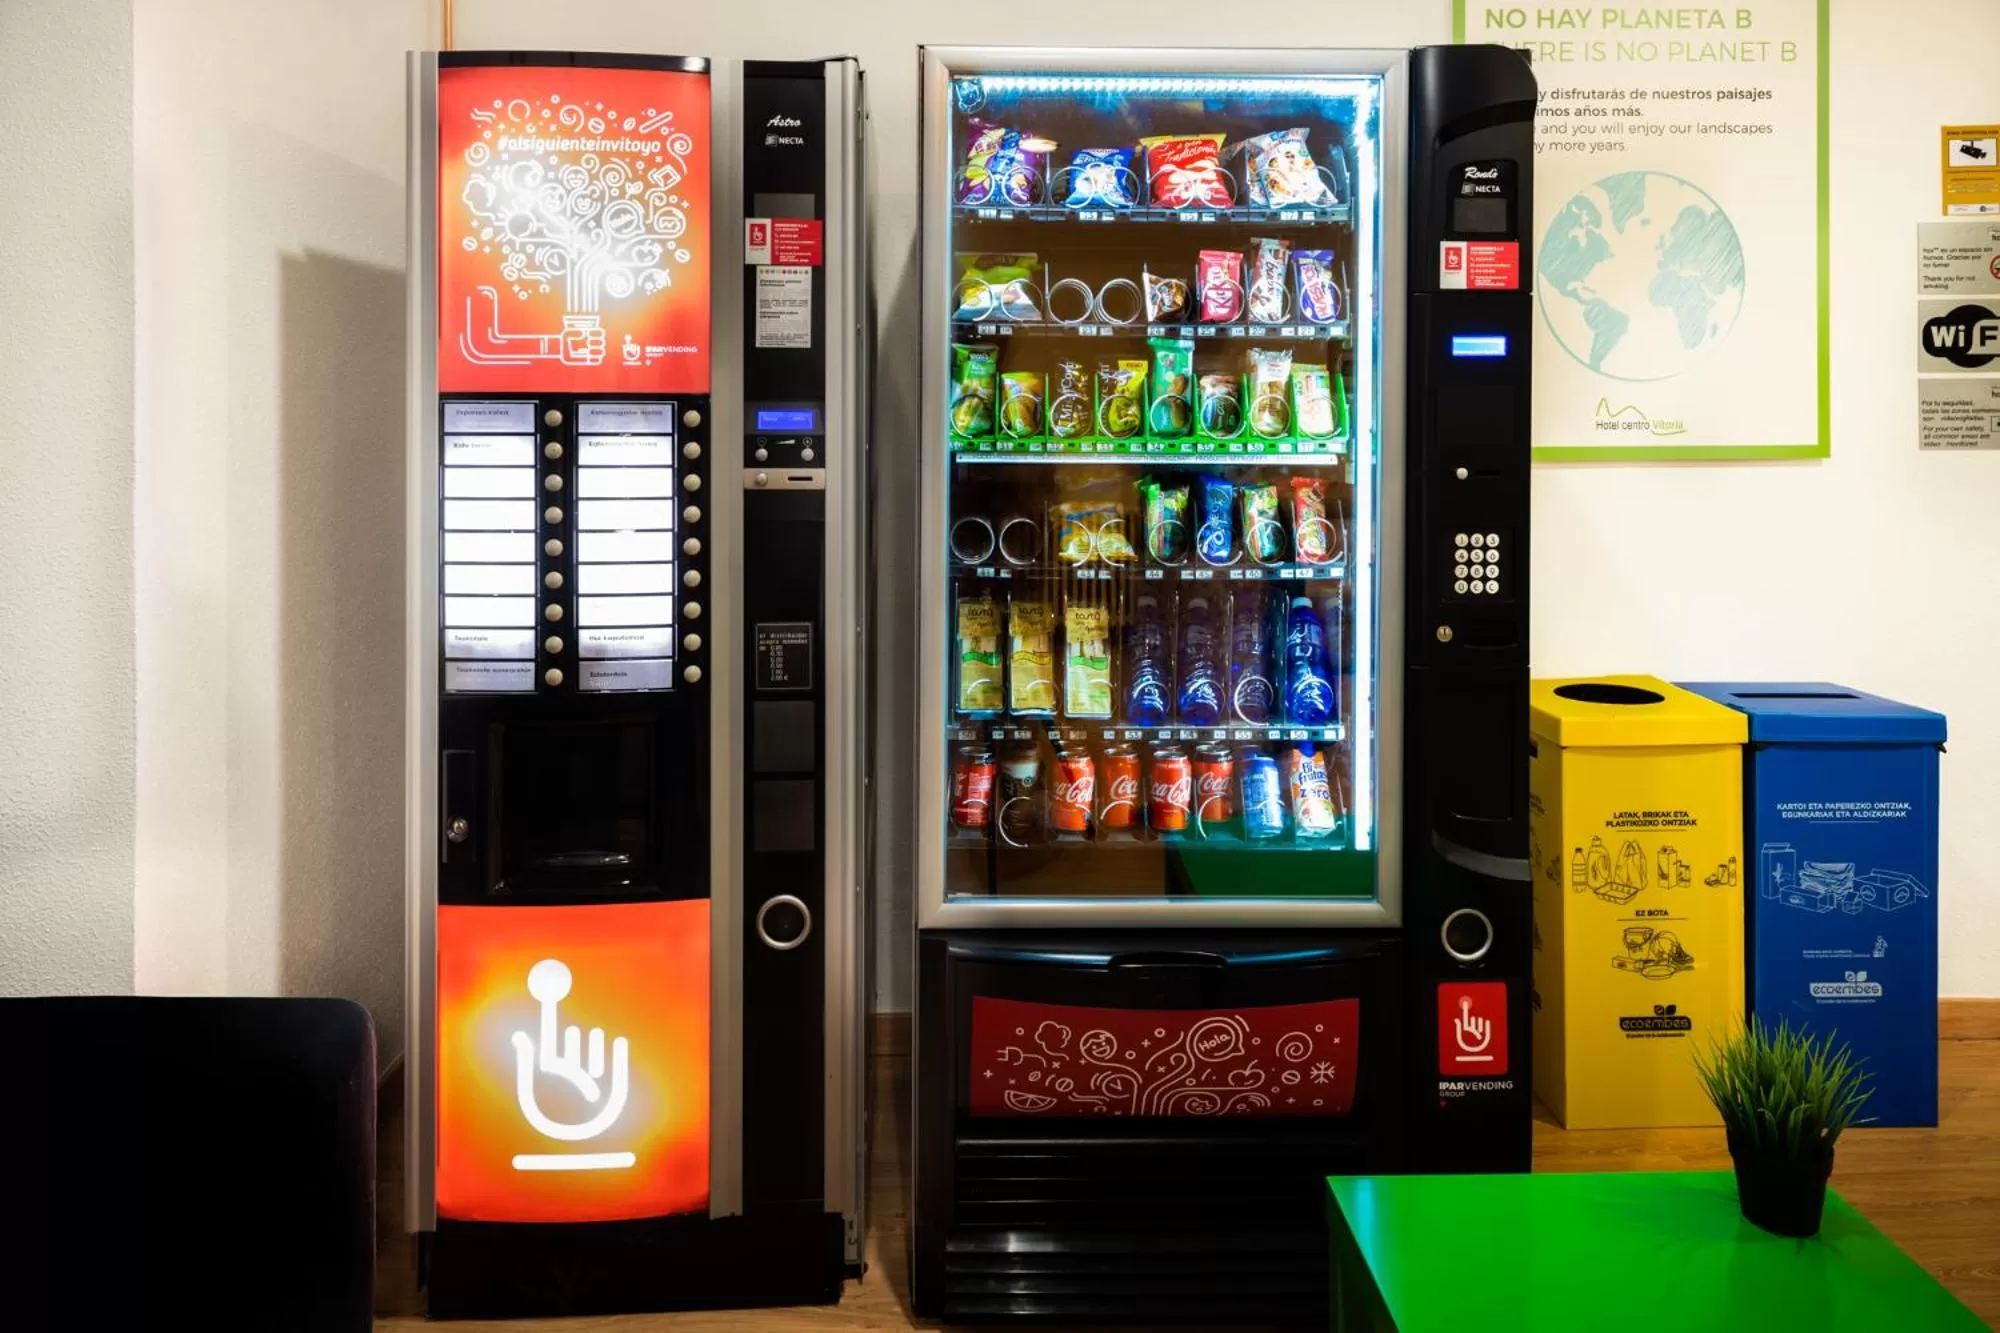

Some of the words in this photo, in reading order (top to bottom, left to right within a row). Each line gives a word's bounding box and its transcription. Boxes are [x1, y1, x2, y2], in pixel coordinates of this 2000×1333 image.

[1485, 9, 1526, 29] NO
[1537, 9, 1592, 29] HAY
[1602, 9, 1726, 29] PLANETA
[1736, 9, 1752, 29] B
[1585, 41, 1606, 62] IS
[1617, 41, 1658, 62] NO
[1668, 41, 1771, 62] PLANET
[1781, 42, 1797, 62] B
[1539, 90, 1547, 102] y
[1551, 88, 1625, 100] disfrutarás
[1630, 88, 1647, 100] de
[1652, 89, 1712, 100] nuestros
[1717, 88, 1772, 102] paisajes
[1574, 105, 1607, 117] años
[1612, 105, 1643, 117] más.
[766, 115, 801, 127] Astro
[1541, 121, 1568, 134] and
[1572, 124, 1596, 136] you
[1601, 121, 1624, 134] will
[1628, 123, 1665, 136] enjoy
[1669, 124, 1692, 134] our
[1697, 121, 1773, 135] landscapes
[779, 136, 804, 145] NECTA
[1549, 141, 1586, 151] more
[1475, 185, 1501, 193] NECTA
[1596, 420, 1619, 430] Hotel
[1622, 420, 1650, 430] centro
[1613, 811, 1640, 820] LATAK,
[1635, 909, 1646, 917] EZ
[1648, 909, 1668, 917] BOTA
[1813, 985, 1880, 994] ecoembes
[1622, 1019, 1689, 1029] ecoembes
[1199, 1032, 1232, 1053] Hola
[1439, 1081, 1514, 1091] IPARVENDING
